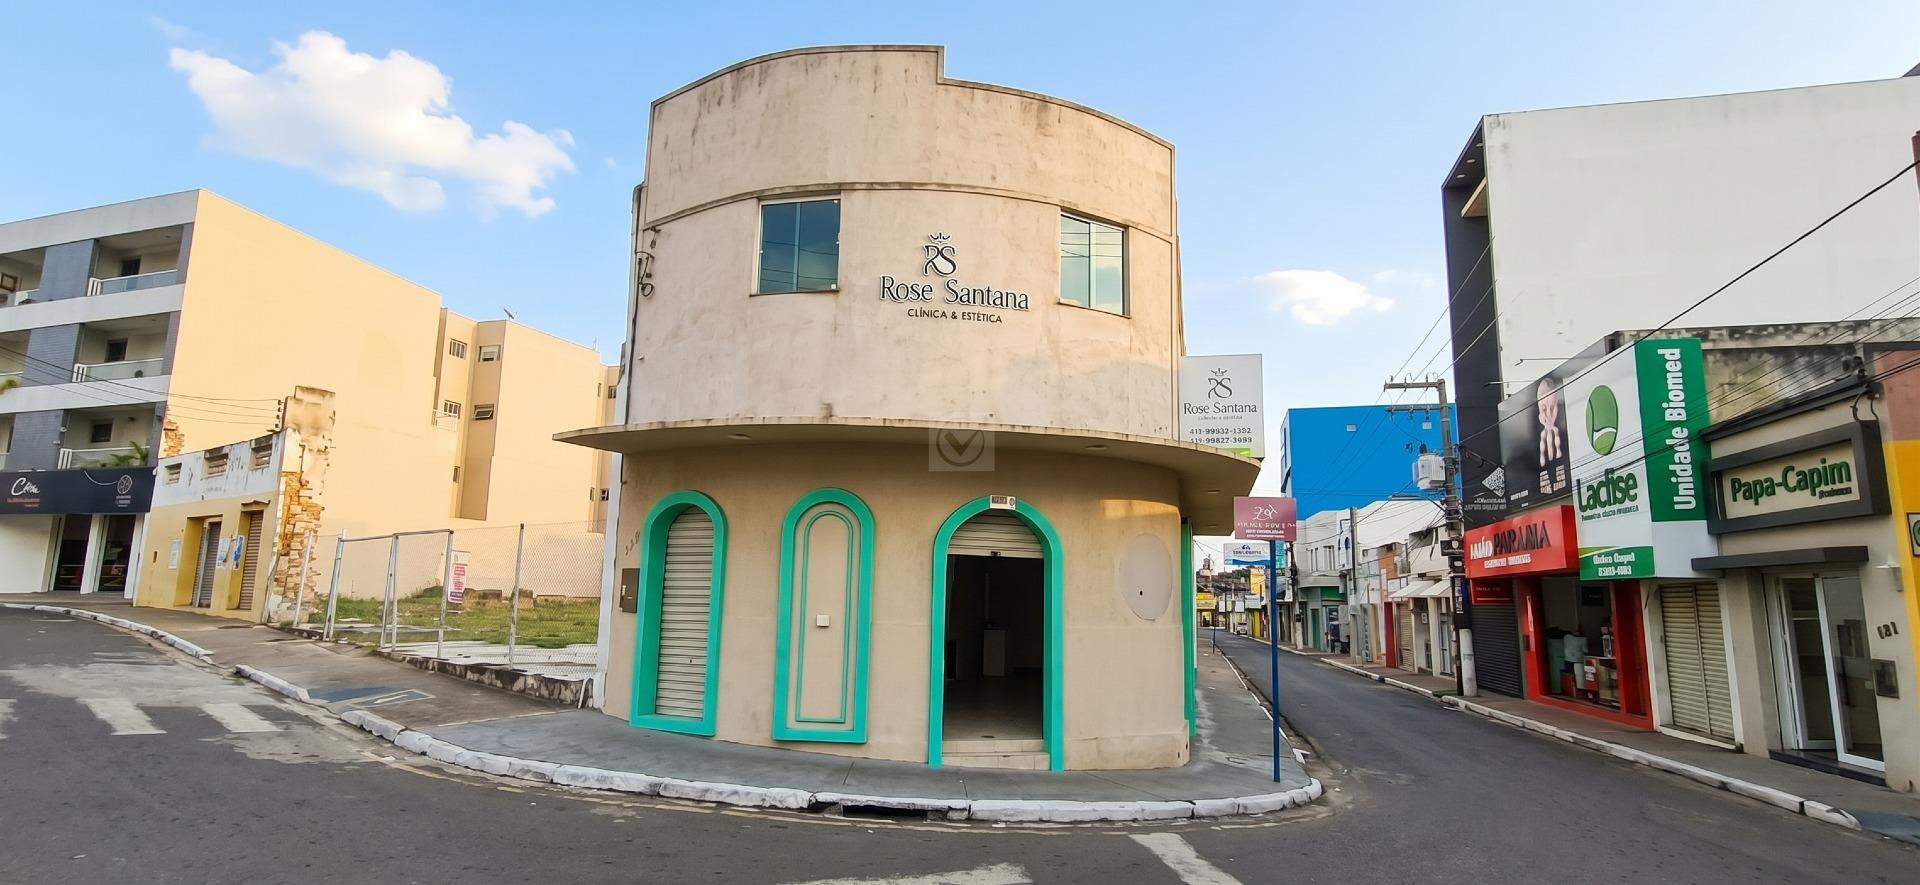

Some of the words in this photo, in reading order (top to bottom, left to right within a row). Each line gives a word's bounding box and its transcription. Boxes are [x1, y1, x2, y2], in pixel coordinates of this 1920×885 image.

[881, 275, 934, 303] Rose
[945, 278, 1030, 310] Santana
[907, 306, 948, 319] CLÍNICA
[951, 311, 958, 320] &
[961, 310, 1003, 324] ESTÉTICA
[1657, 348, 1687, 422] Biomed
[1183, 402, 1210, 415] Rose
[1213, 401, 1258, 414] Santana
[1665, 426, 1697, 510] Unidade
[1730, 457, 1852, 506] Papa-Capim
